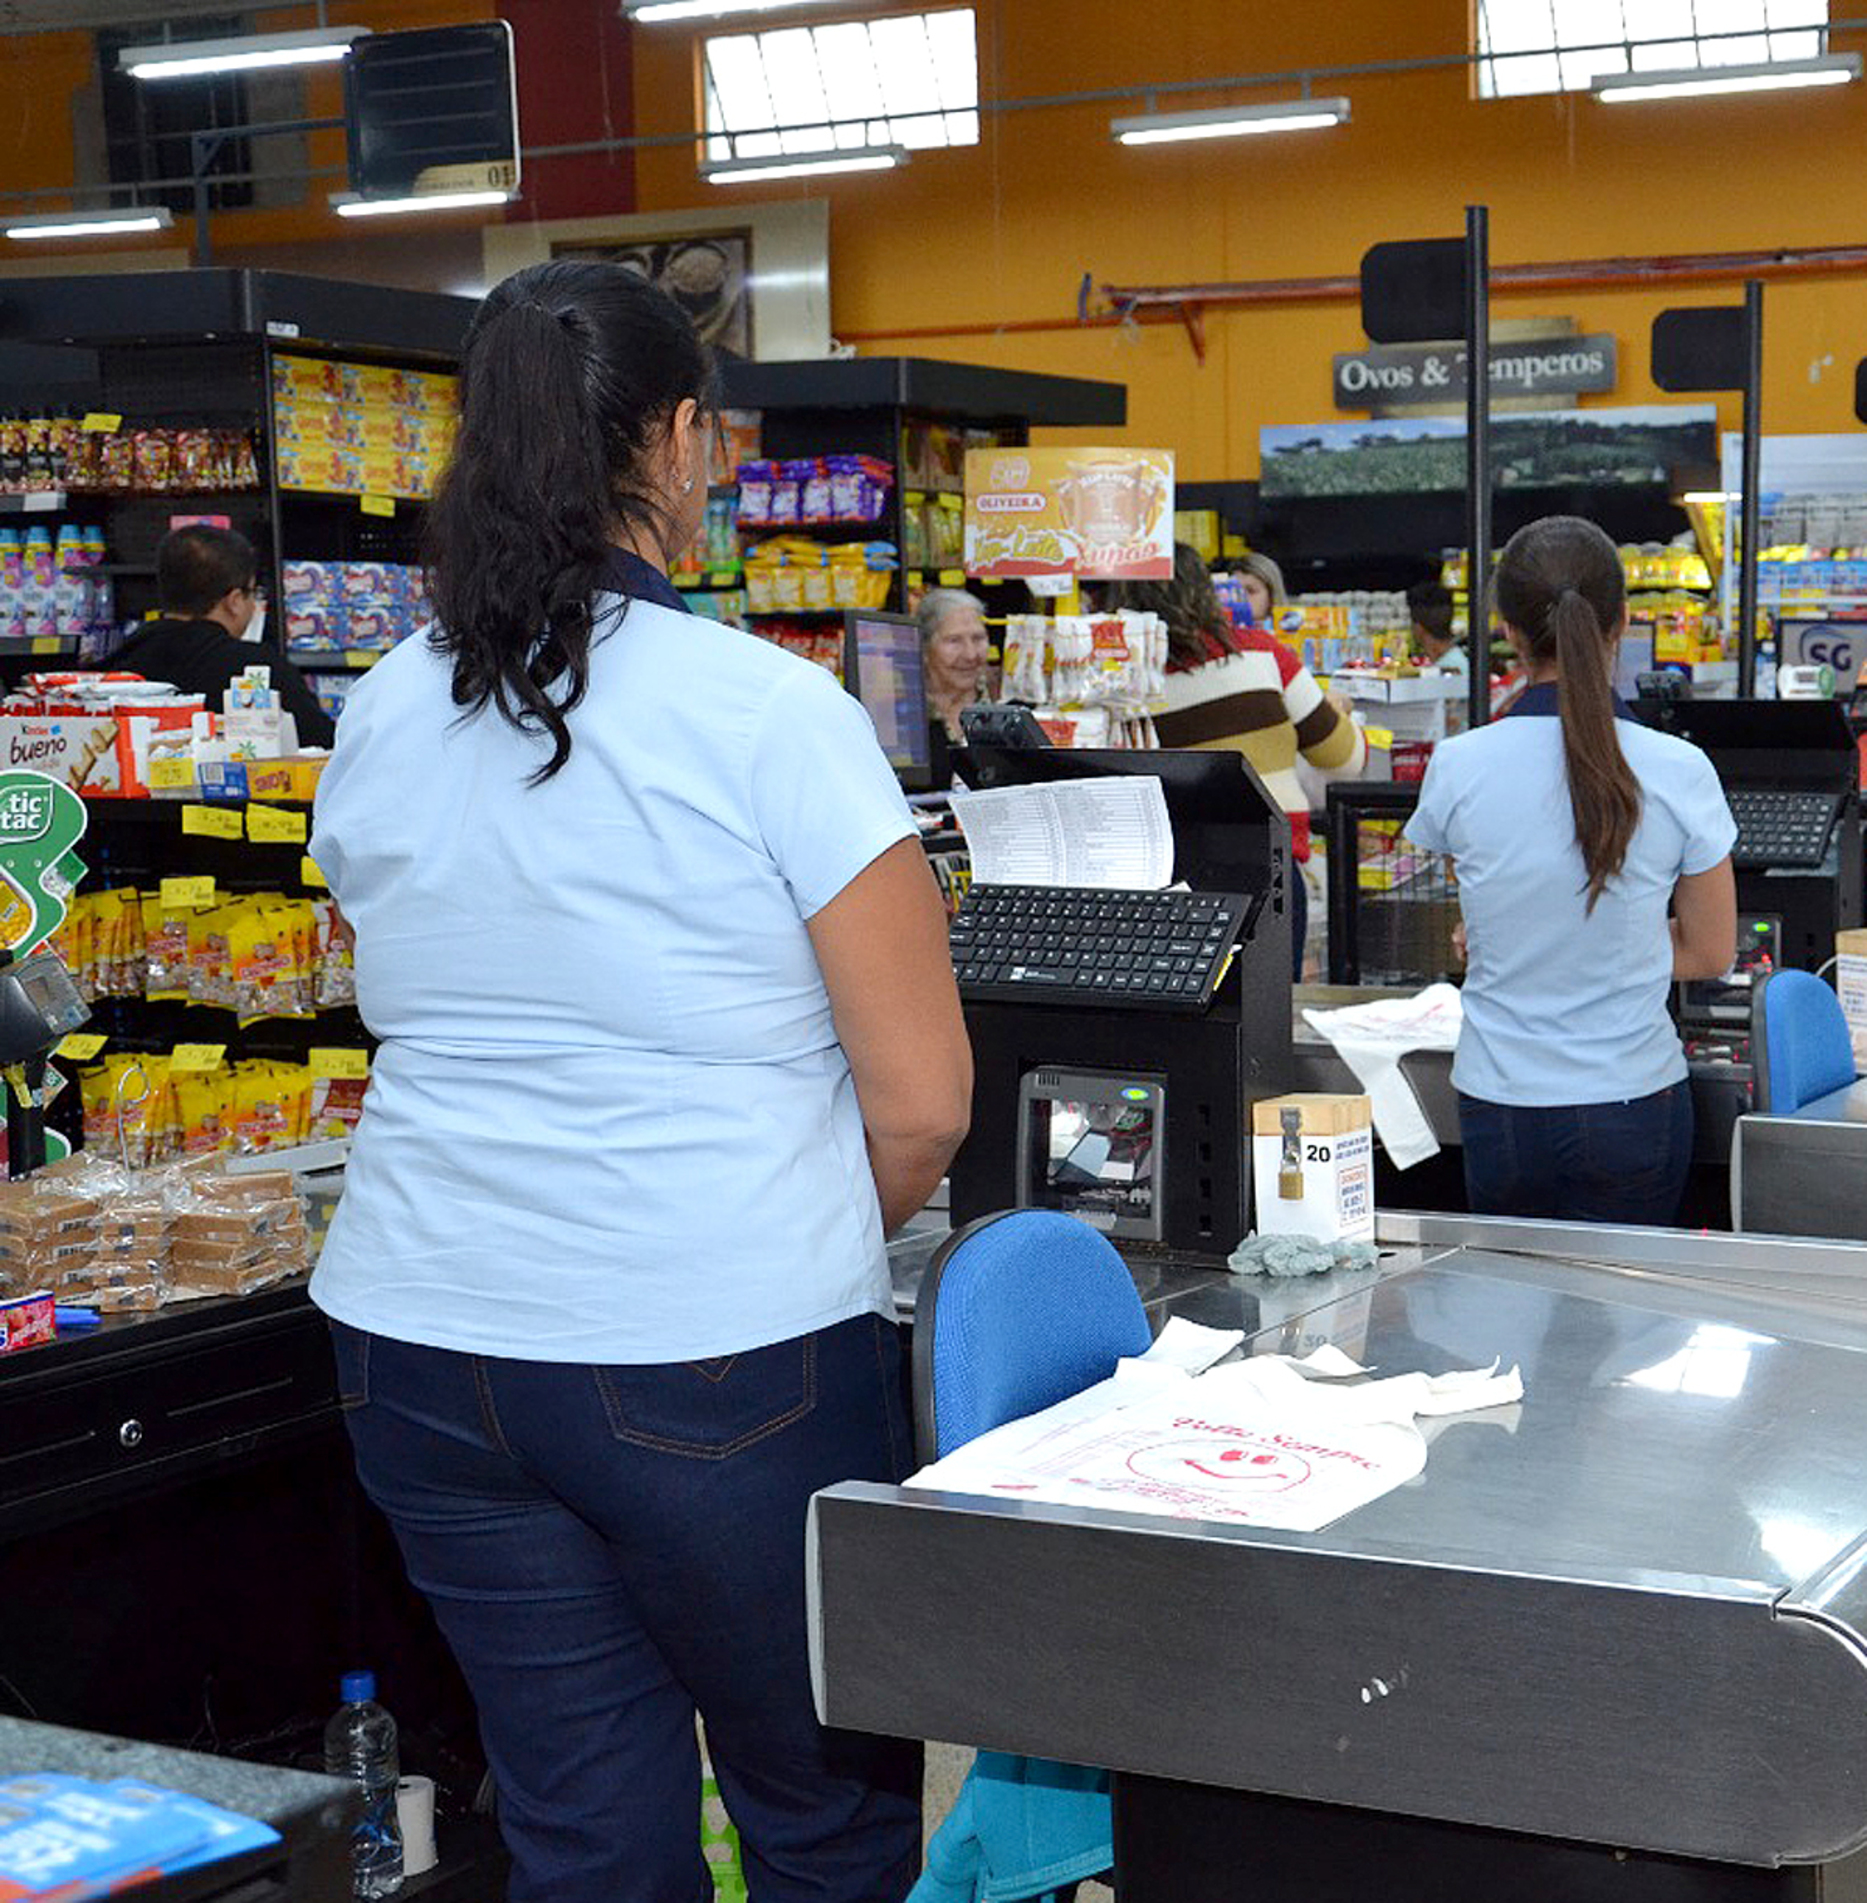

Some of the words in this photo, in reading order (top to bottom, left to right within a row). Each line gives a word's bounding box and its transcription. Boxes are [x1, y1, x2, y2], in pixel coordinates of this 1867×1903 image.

[1340, 361, 1414, 391] Ovos
[1420, 356, 1450, 386] &
[1809, 643, 1852, 672] SG
[10, 736, 67, 765] bueno
[9, 791, 42, 813] tic
[0, 811, 42, 830] tac
[1306, 1144, 1331, 1163] 20
